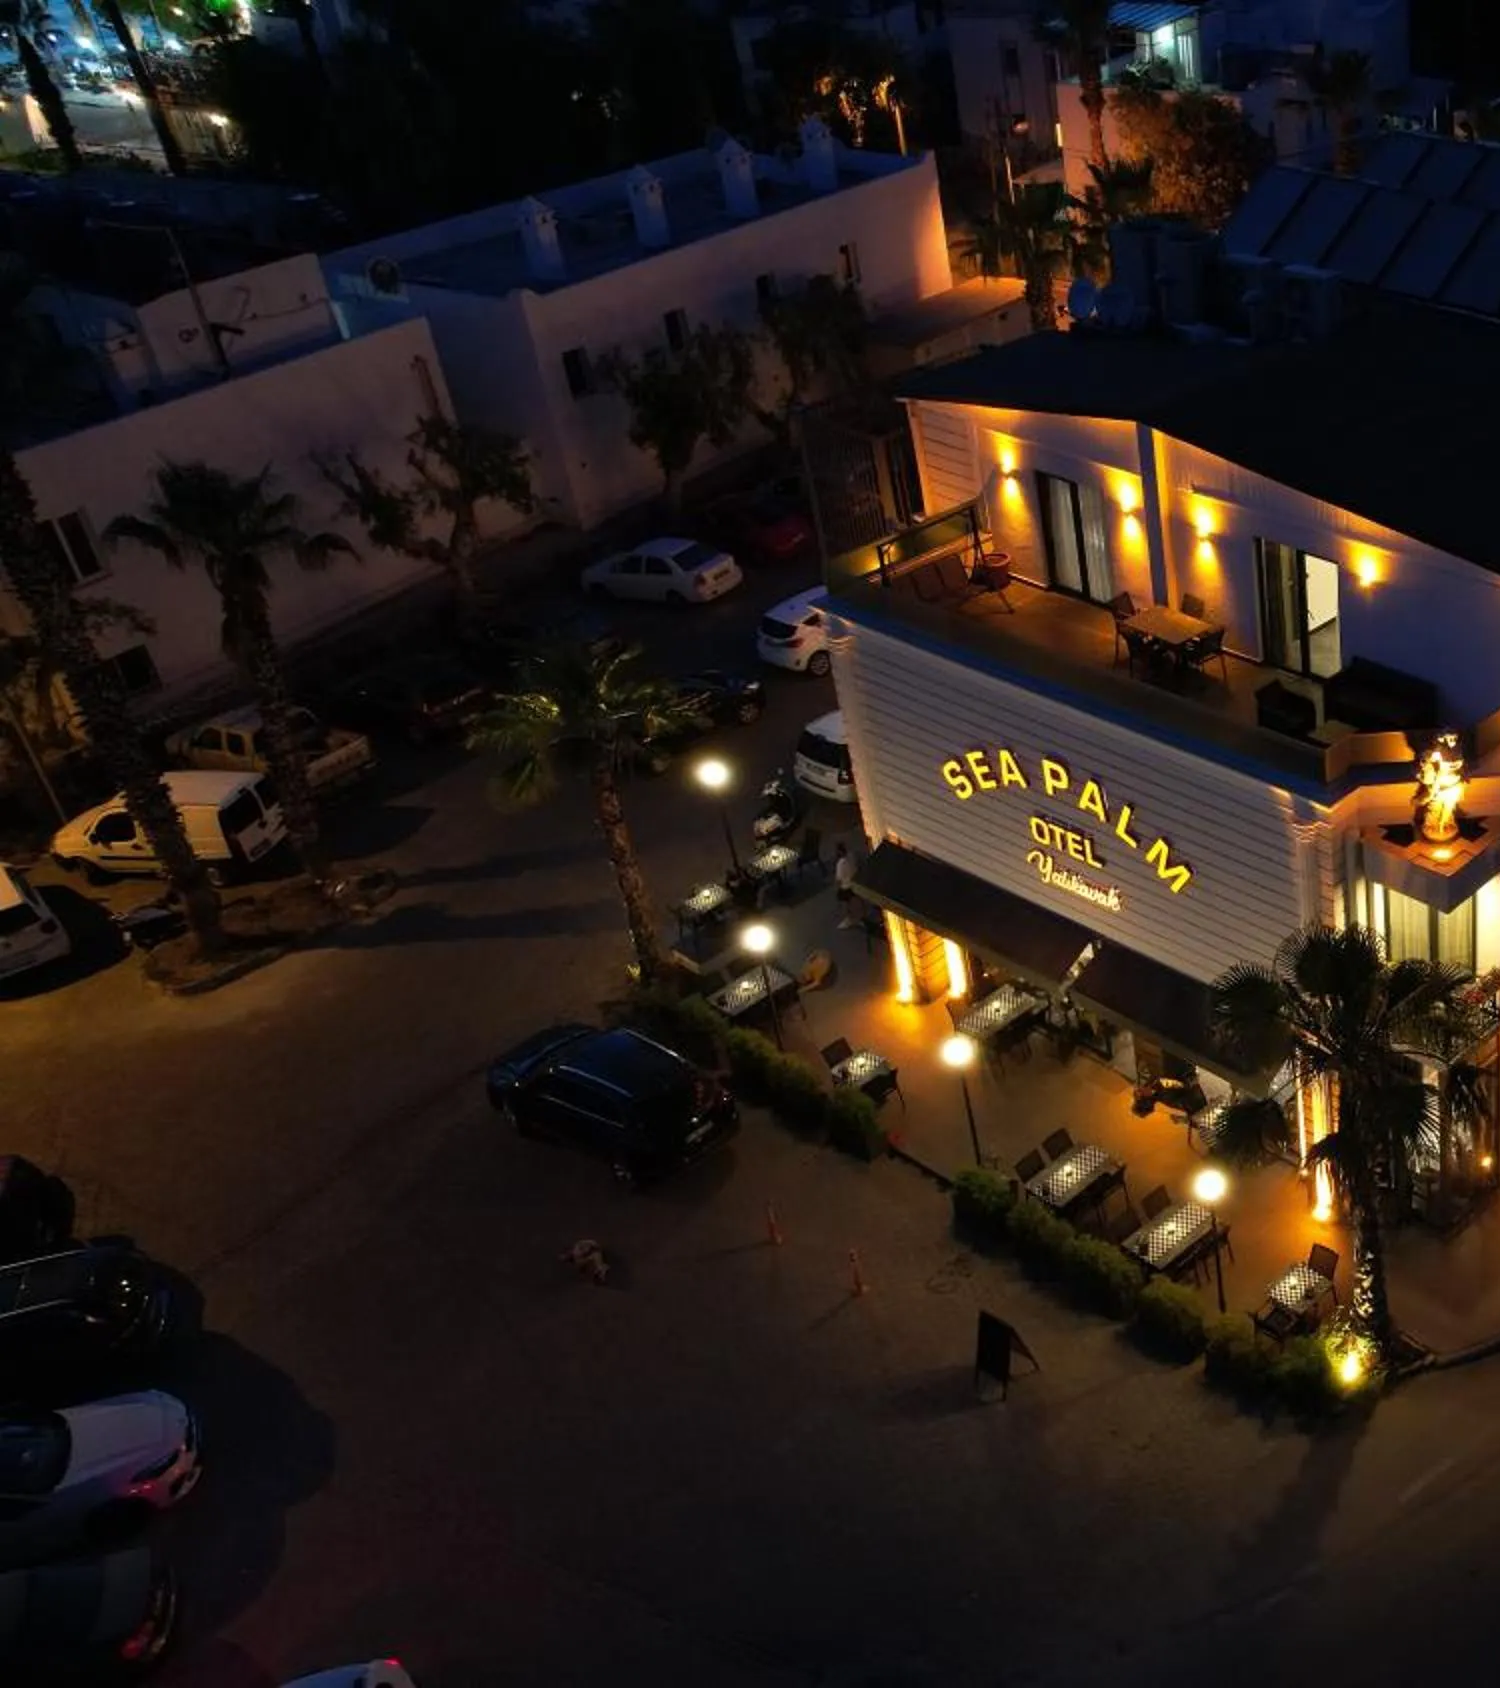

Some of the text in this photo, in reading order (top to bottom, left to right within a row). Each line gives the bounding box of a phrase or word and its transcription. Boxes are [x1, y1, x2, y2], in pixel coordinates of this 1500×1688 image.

[943, 750, 1191, 894] SEA PALM
[1029, 816, 1102, 869] OTEL
